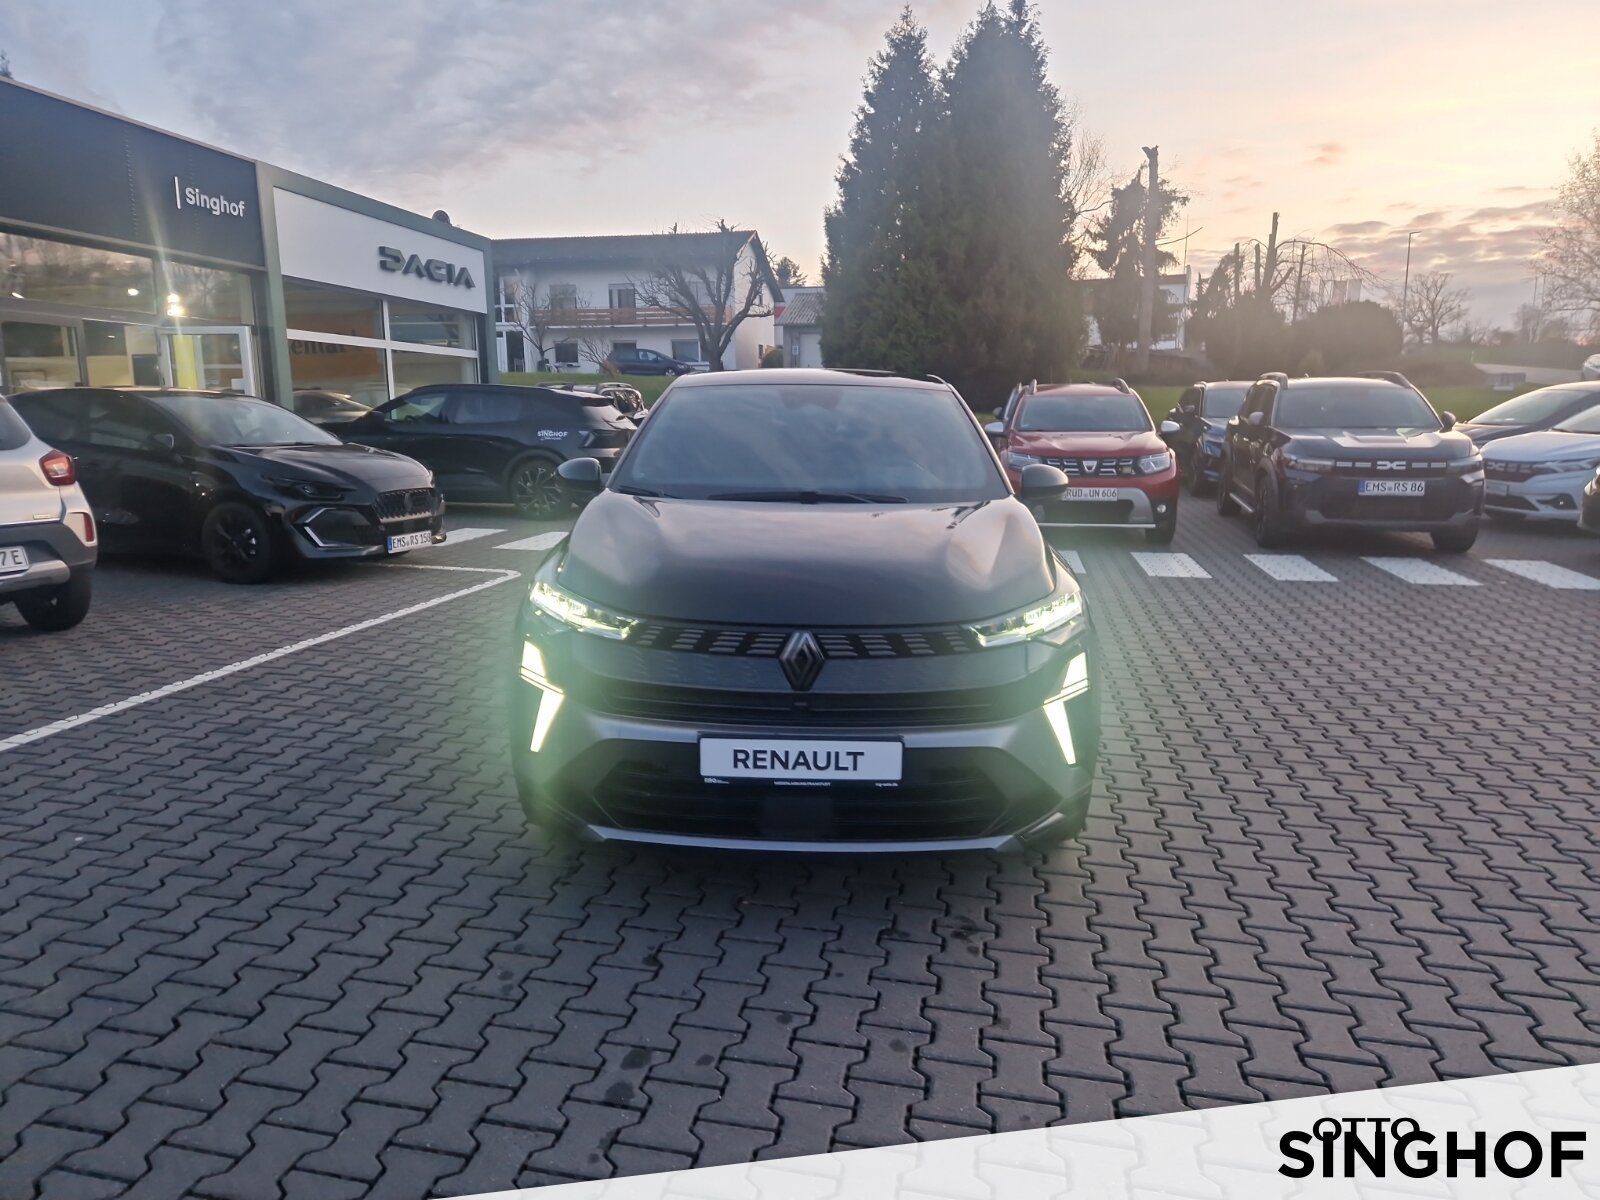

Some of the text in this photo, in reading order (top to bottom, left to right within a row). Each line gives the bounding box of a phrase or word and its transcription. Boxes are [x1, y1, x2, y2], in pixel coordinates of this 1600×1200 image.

[185, 187, 246, 217] Singhof
[378, 245, 476, 290] DACIA
[1089, 488, 1100, 498] UN
[1102, 488, 1117, 498] 606
[1365, 482, 1424, 492] EMS RS 86
[392, 536, 406, 548] EMS
[409, 534, 419, 545] RS
[733, 748, 865, 771] RENAULT
